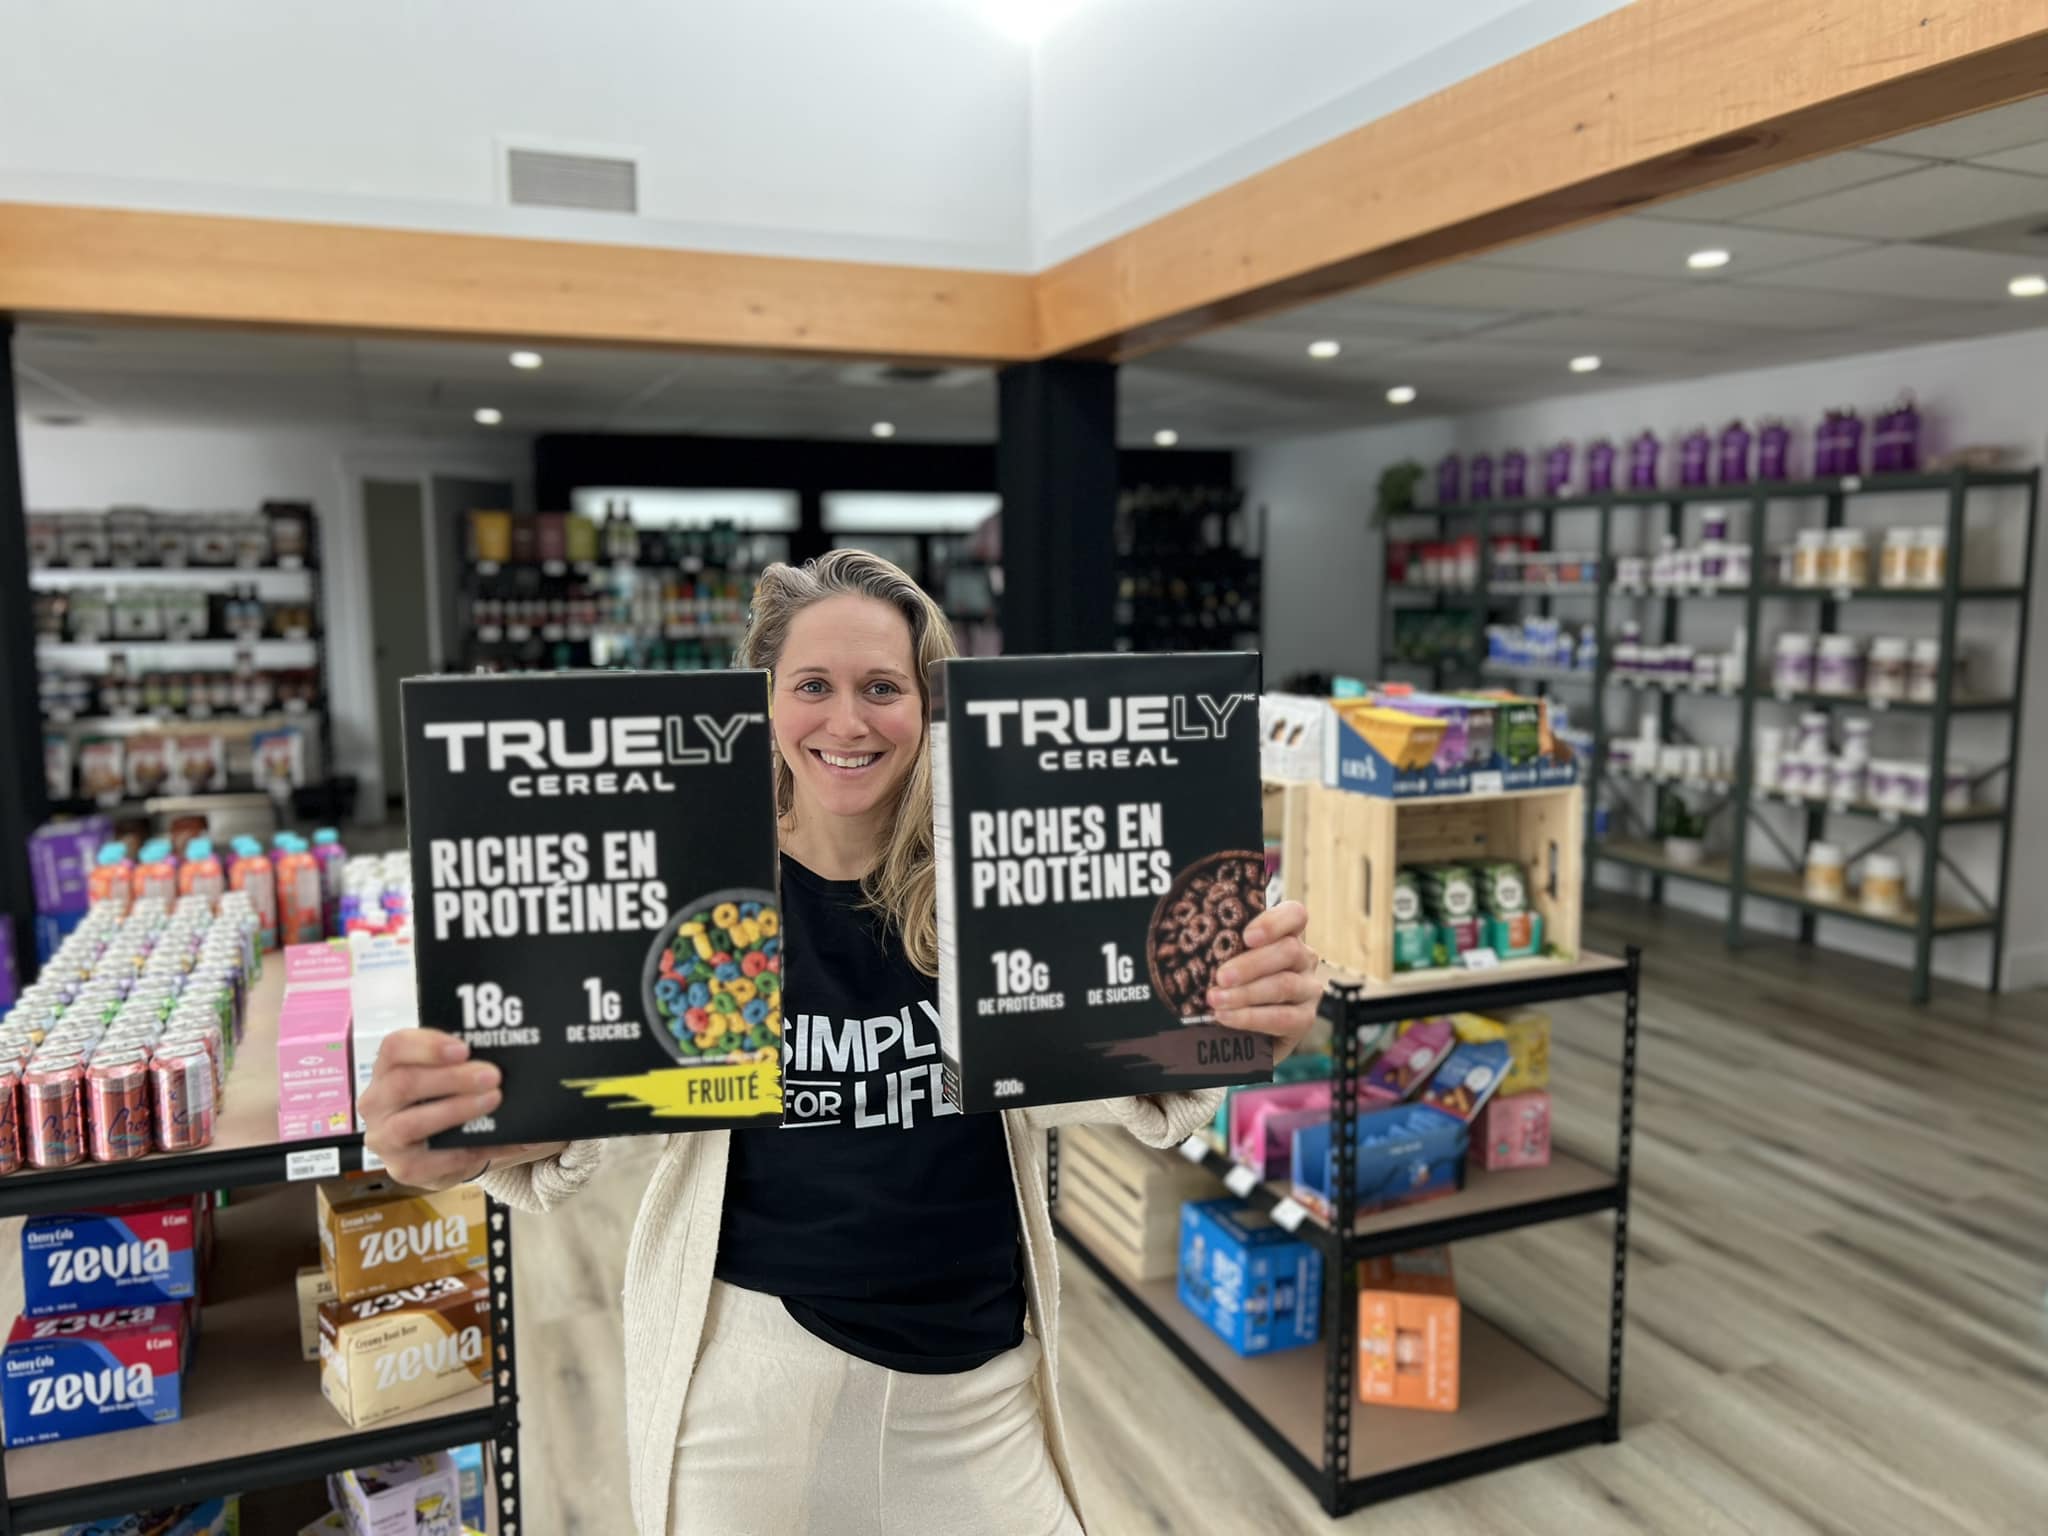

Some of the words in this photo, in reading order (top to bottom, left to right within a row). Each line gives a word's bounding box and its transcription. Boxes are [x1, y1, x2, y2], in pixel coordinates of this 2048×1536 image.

[966, 694, 1242, 747] TRUELY
[424, 713, 748, 772] TRUELY
[1039, 747, 1178, 771] CEREAL
[509, 771, 675, 797] CEREAL
[970, 805, 1106, 858] RICHES
[1117, 803, 1163, 849] EN
[430, 833, 589, 889] RICHES
[603, 830, 658, 880] EN
[971, 849, 1173, 909] PROTÉINES
[433, 878, 669, 941] PROTÉINES
[978, 998, 996, 1015] DE
[999, 992, 1065, 1014] PROTÉINES
[1088, 988, 1103, 1005] DE
[1105, 985, 1150, 1002] SUCRES
[463, 1027, 541, 1048] PROTÉINES
[566, 1026, 584, 1042] DE
[587, 1022, 642, 1041] SUCRES
[1197, 1036, 1255, 1066] CACAO
[687, 1070, 760, 1105] FRUITÉ
[27, 1230, 55, 1244] Cherry
[55, 1228, 74, 1241] Cola
[153, 1338, 173, 1350] Cans
[7, 1358, 35, 1373] Cherry
[35, 1354, 55, 1369] Cola
